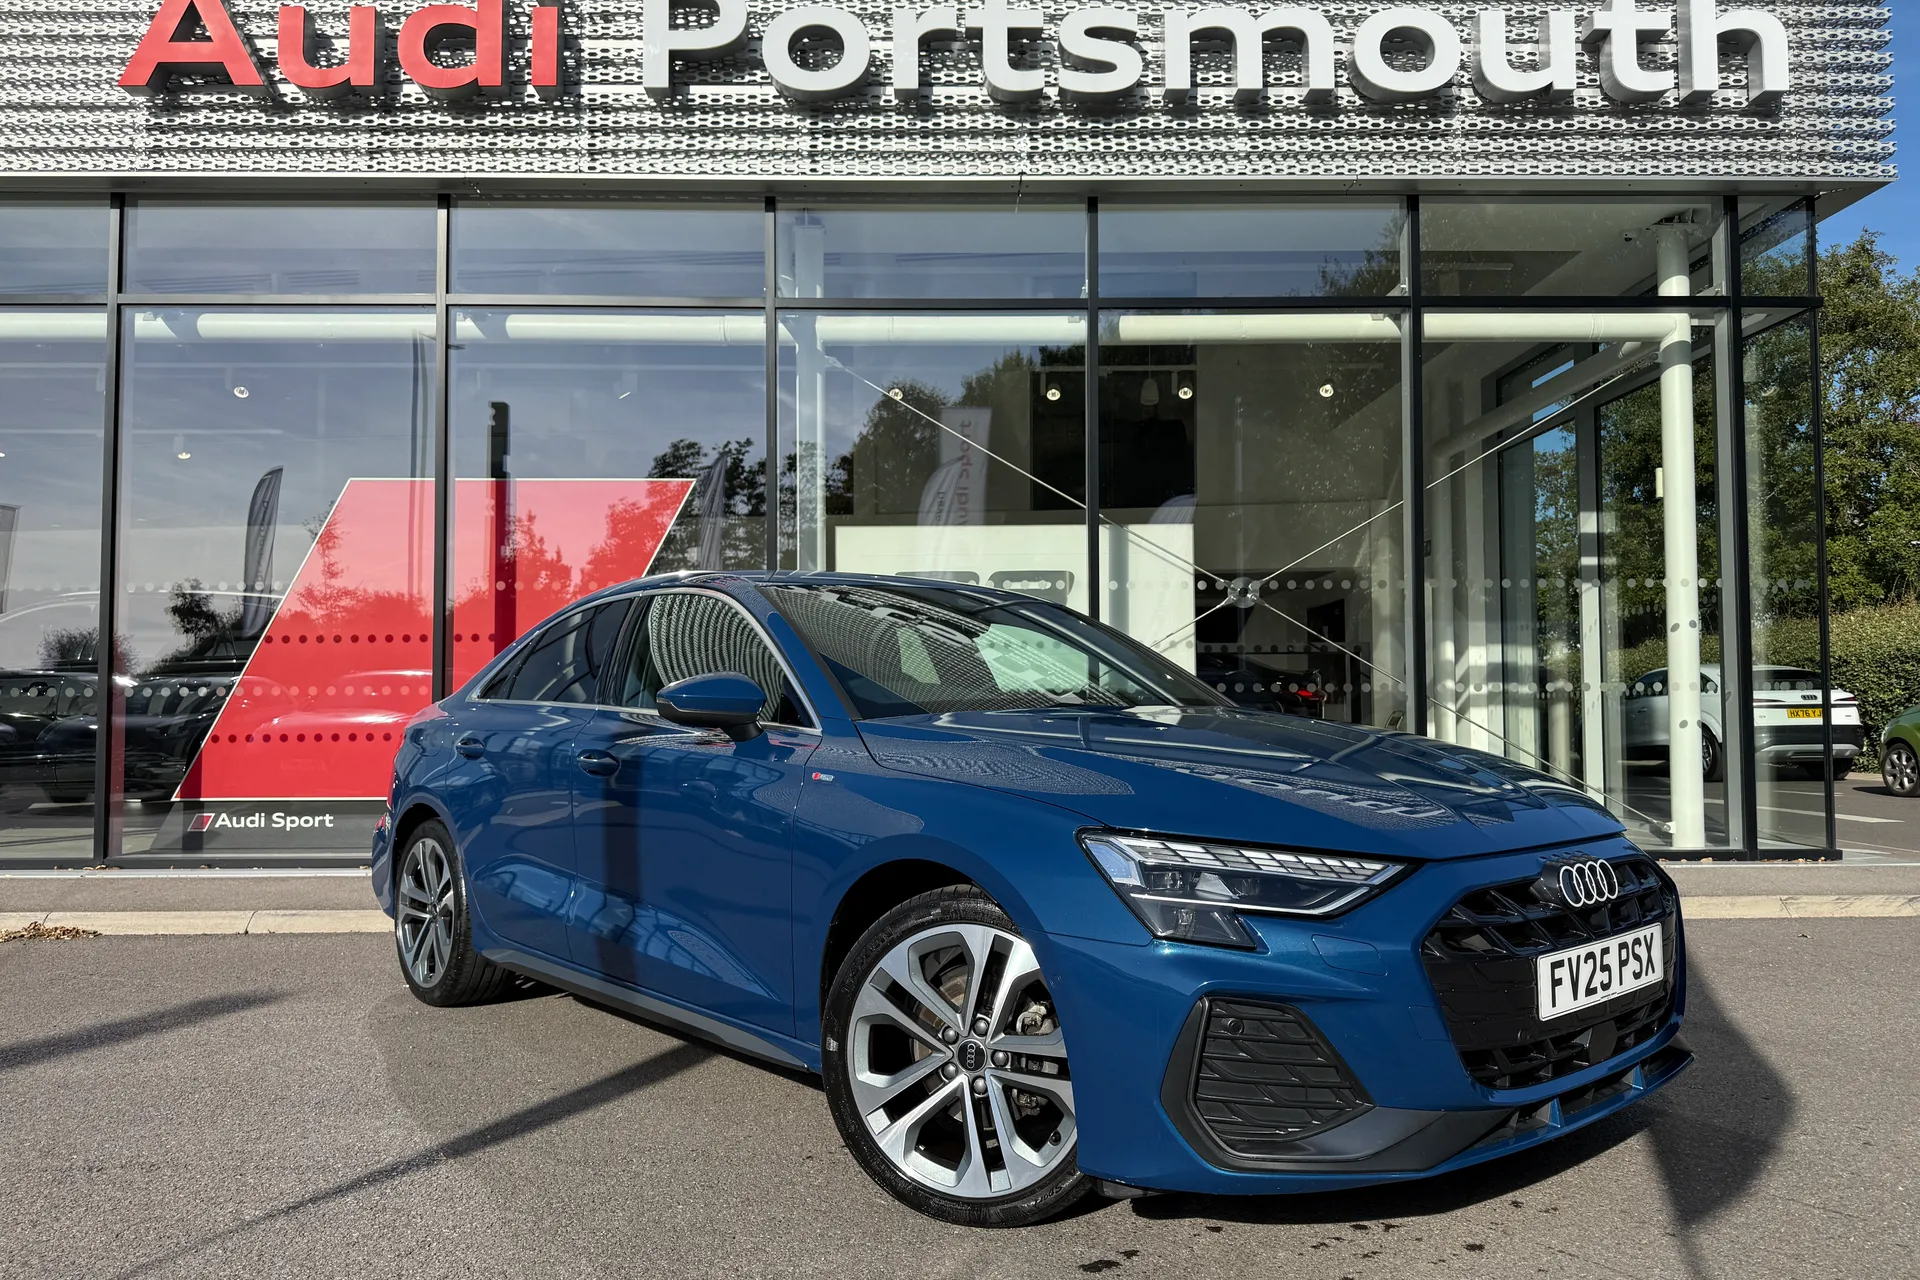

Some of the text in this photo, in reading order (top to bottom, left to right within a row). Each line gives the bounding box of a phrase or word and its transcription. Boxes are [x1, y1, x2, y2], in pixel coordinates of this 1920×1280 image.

[118, 0, 1790, 97] Audi Portsmouth
[214, 812, 334, 832] Audi Sport
[1550, 932, 1656, 1008] FV25 PSX
